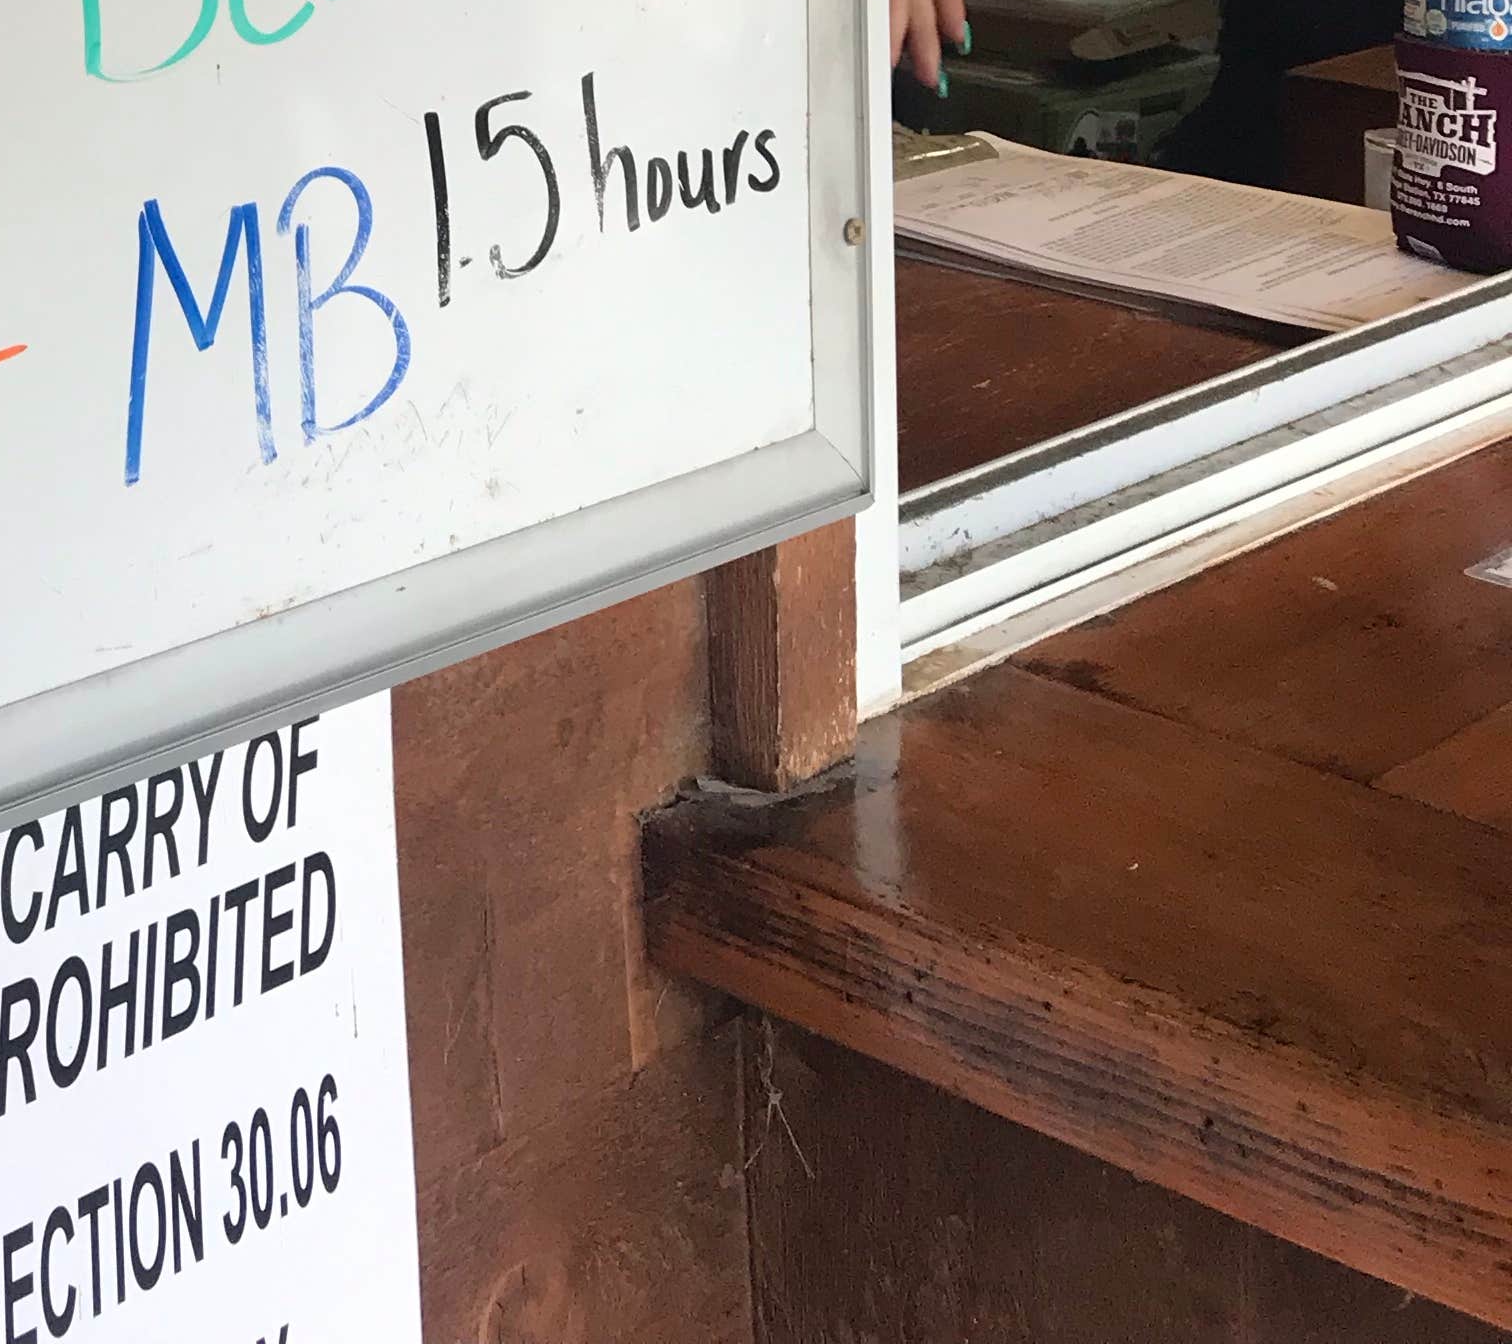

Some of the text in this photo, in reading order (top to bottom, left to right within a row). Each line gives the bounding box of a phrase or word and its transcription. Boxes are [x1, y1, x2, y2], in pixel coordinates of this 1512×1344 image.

[1409, 92, 1439, 110] THE
[124, 166, 412, 487] MB
[581, 72, 781, 234] hours
[0, 751, 225, 945] CARRY
[242, 714, 320, 844] OF
[220, 1072, 342, 1246] 30.06
